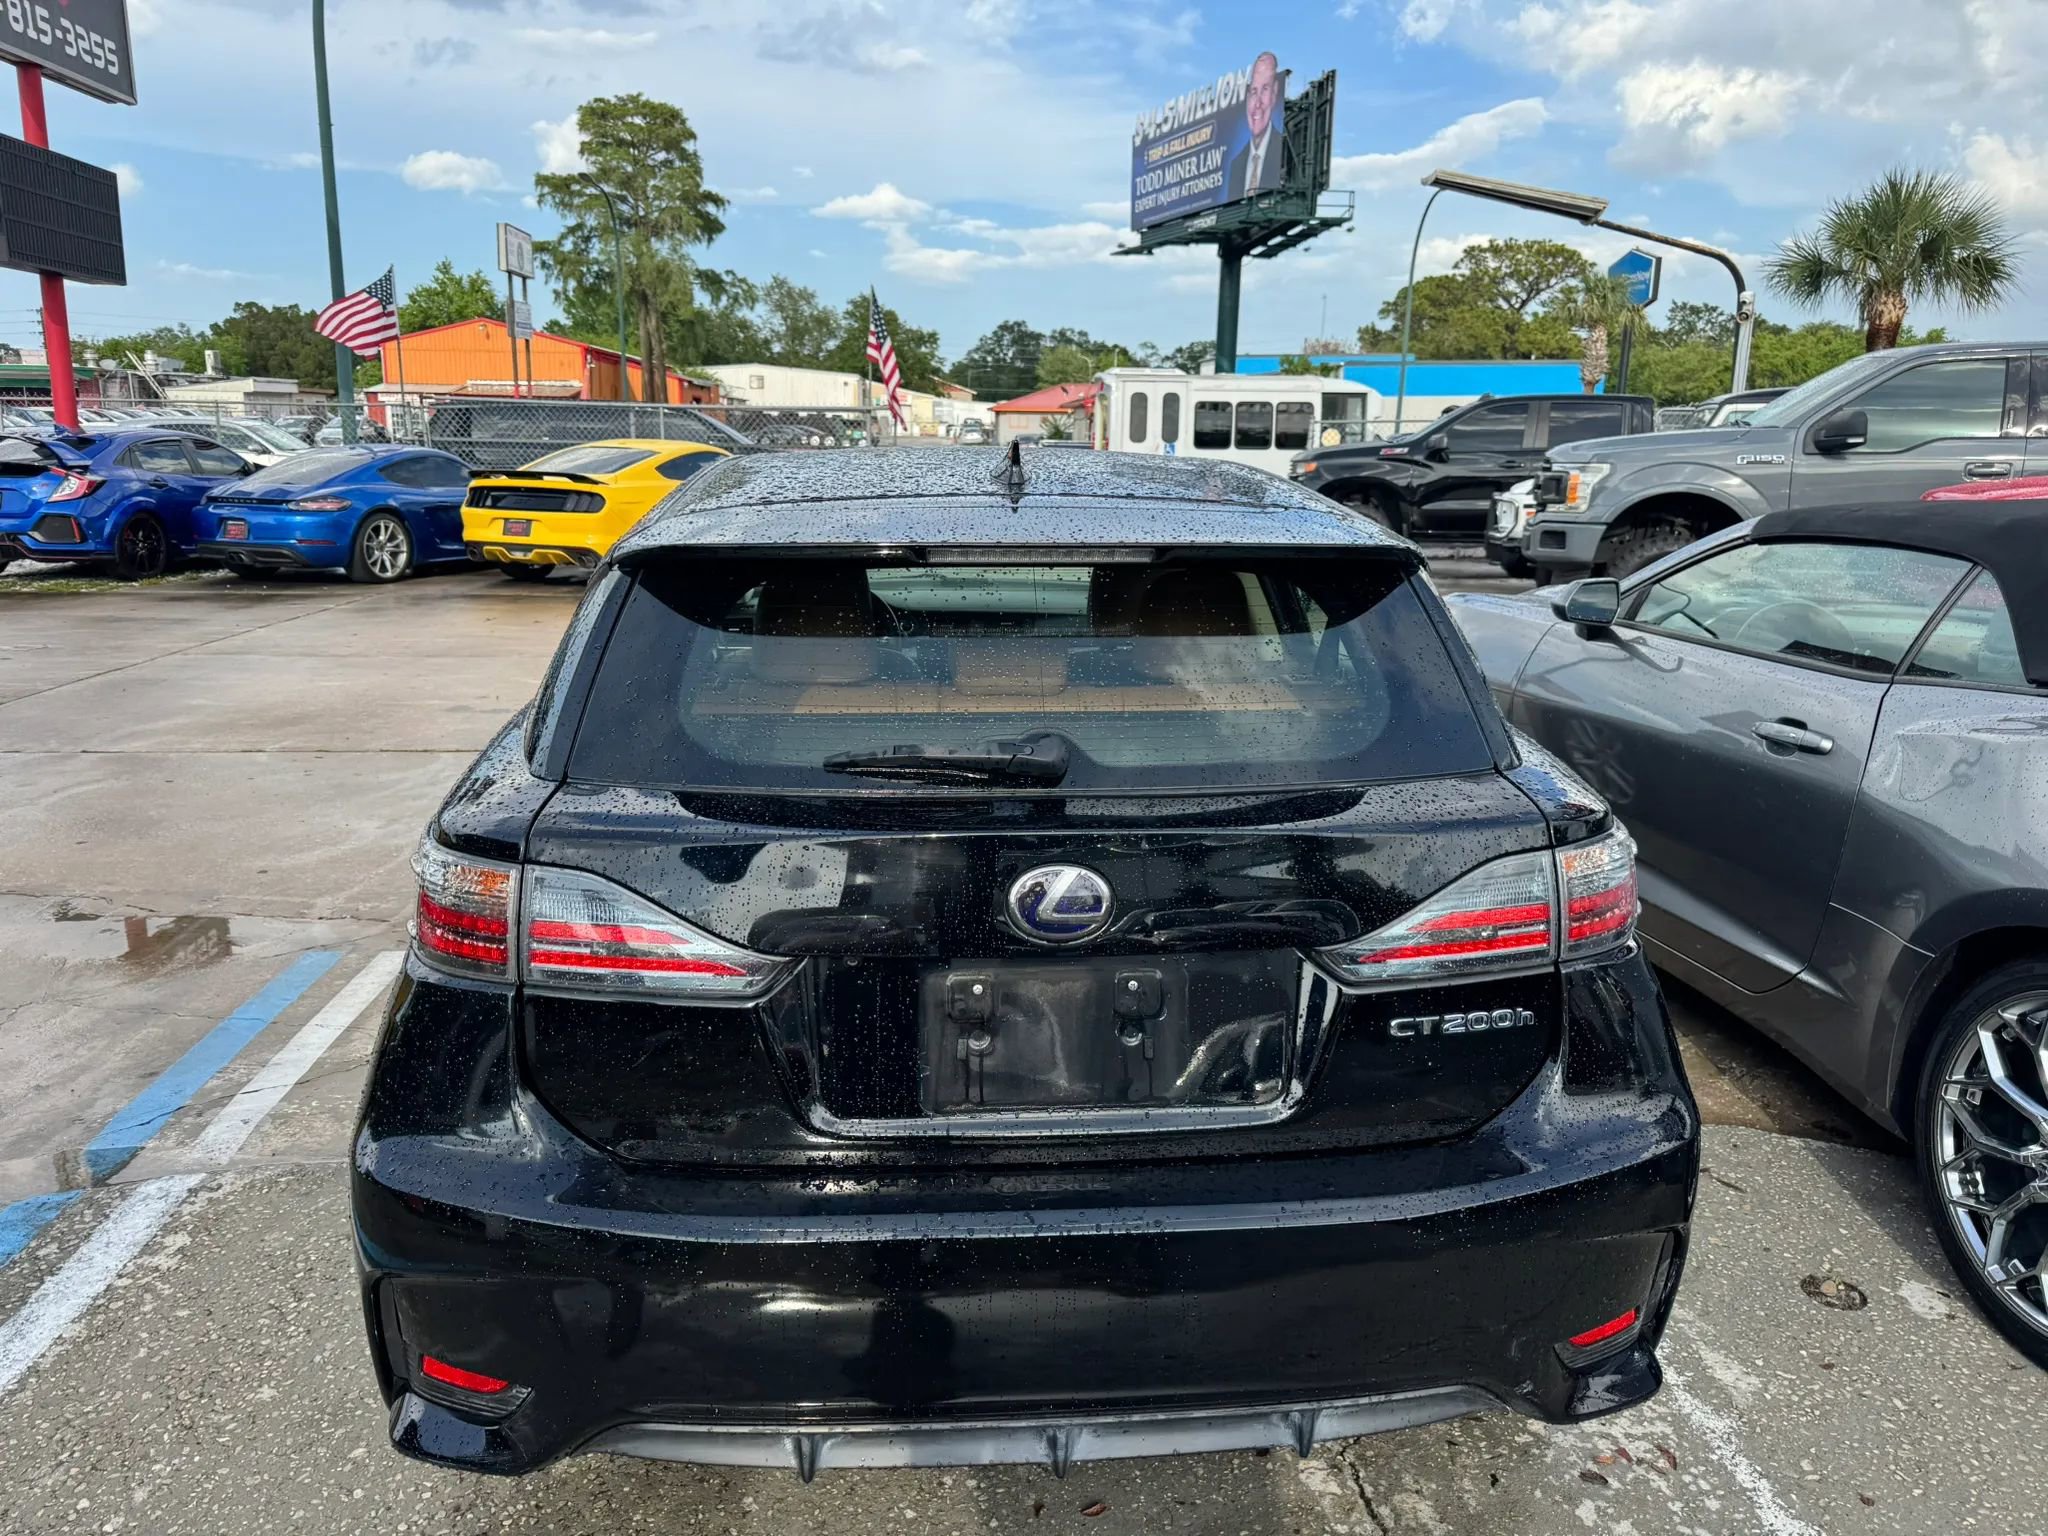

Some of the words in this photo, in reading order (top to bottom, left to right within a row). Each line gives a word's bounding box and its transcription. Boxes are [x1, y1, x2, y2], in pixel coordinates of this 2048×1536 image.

[1135, 169, 1163, 196] TODD
[1163, 156, 1199, 186] MINER
[1135, 194, 1157, 213] EXPERT
[1156, 185, 1181, 206] INJURY
[1180, 171, 1223, 197] ATTORNEYS
